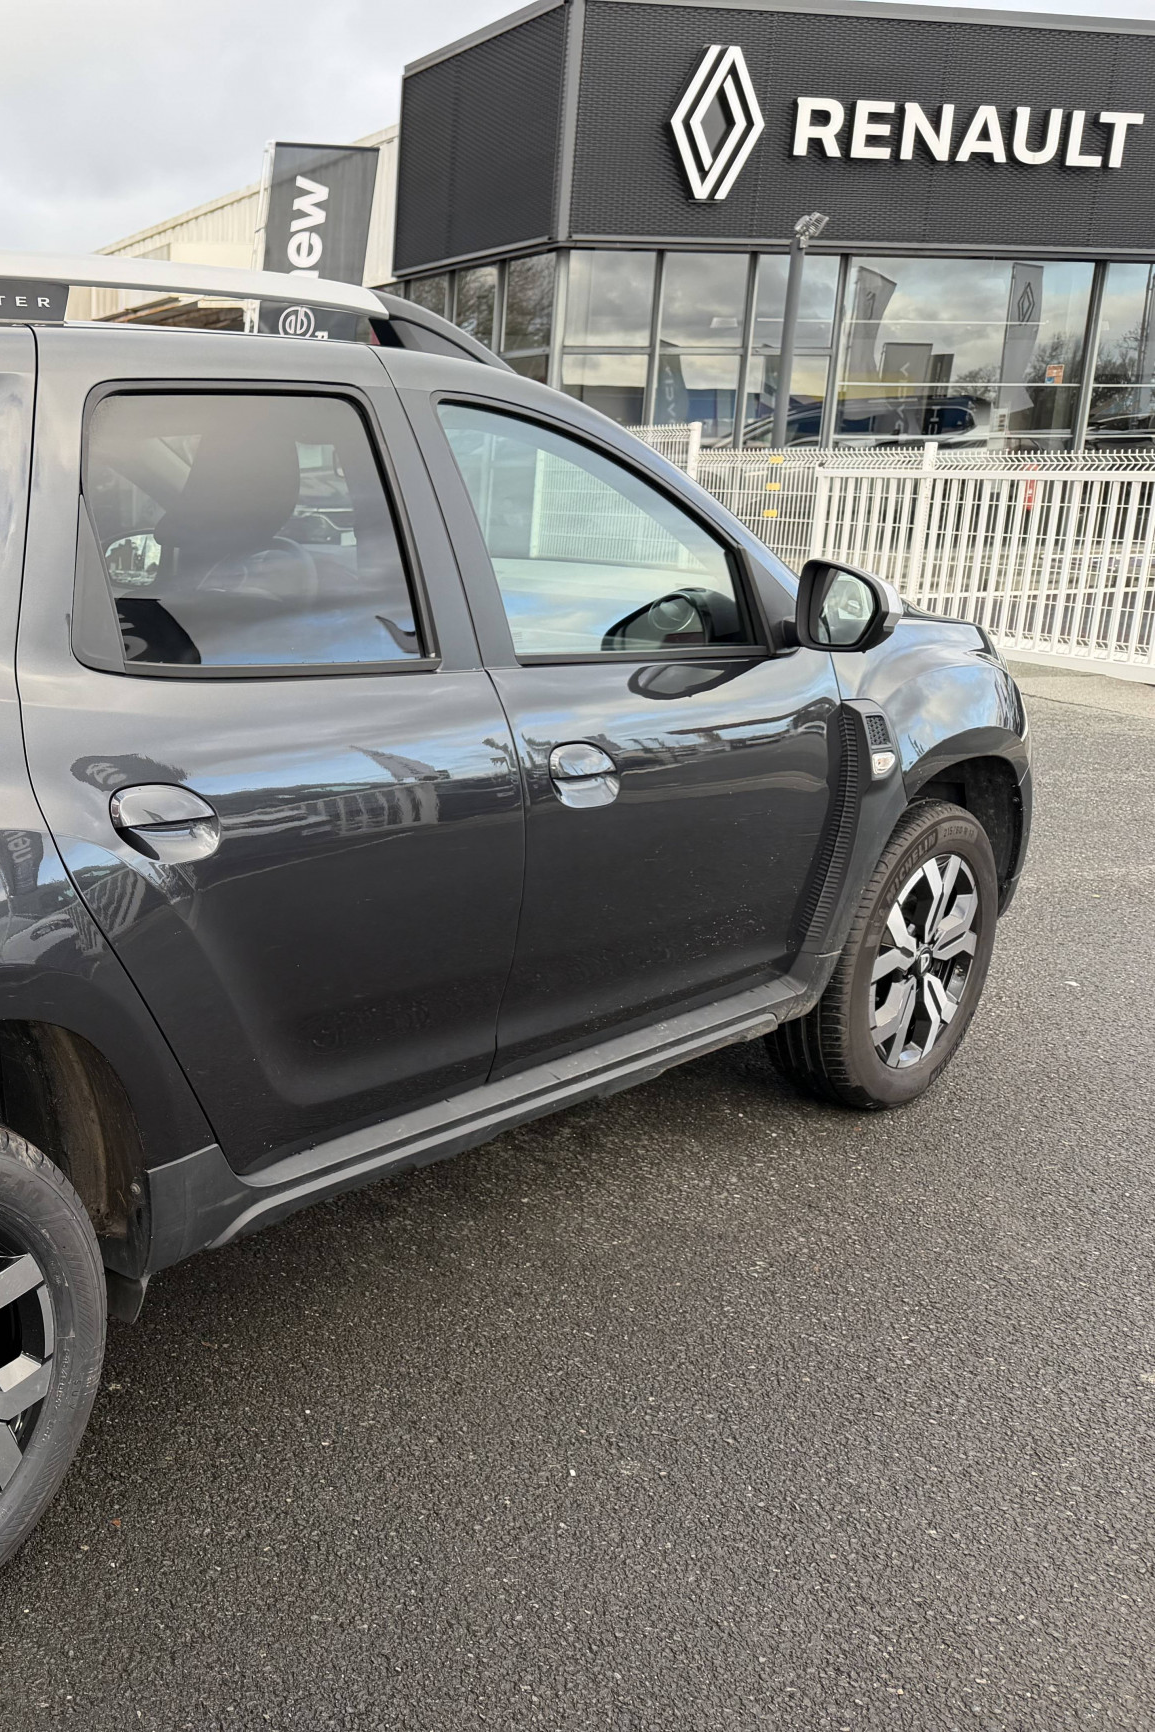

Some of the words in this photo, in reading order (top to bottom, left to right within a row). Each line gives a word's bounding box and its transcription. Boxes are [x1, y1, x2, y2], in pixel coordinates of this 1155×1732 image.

[793, 97, 1145, 168] RENAULT
[287, 175, 329, 279] ew
[886, 831, 937, 907] MICHELIN
